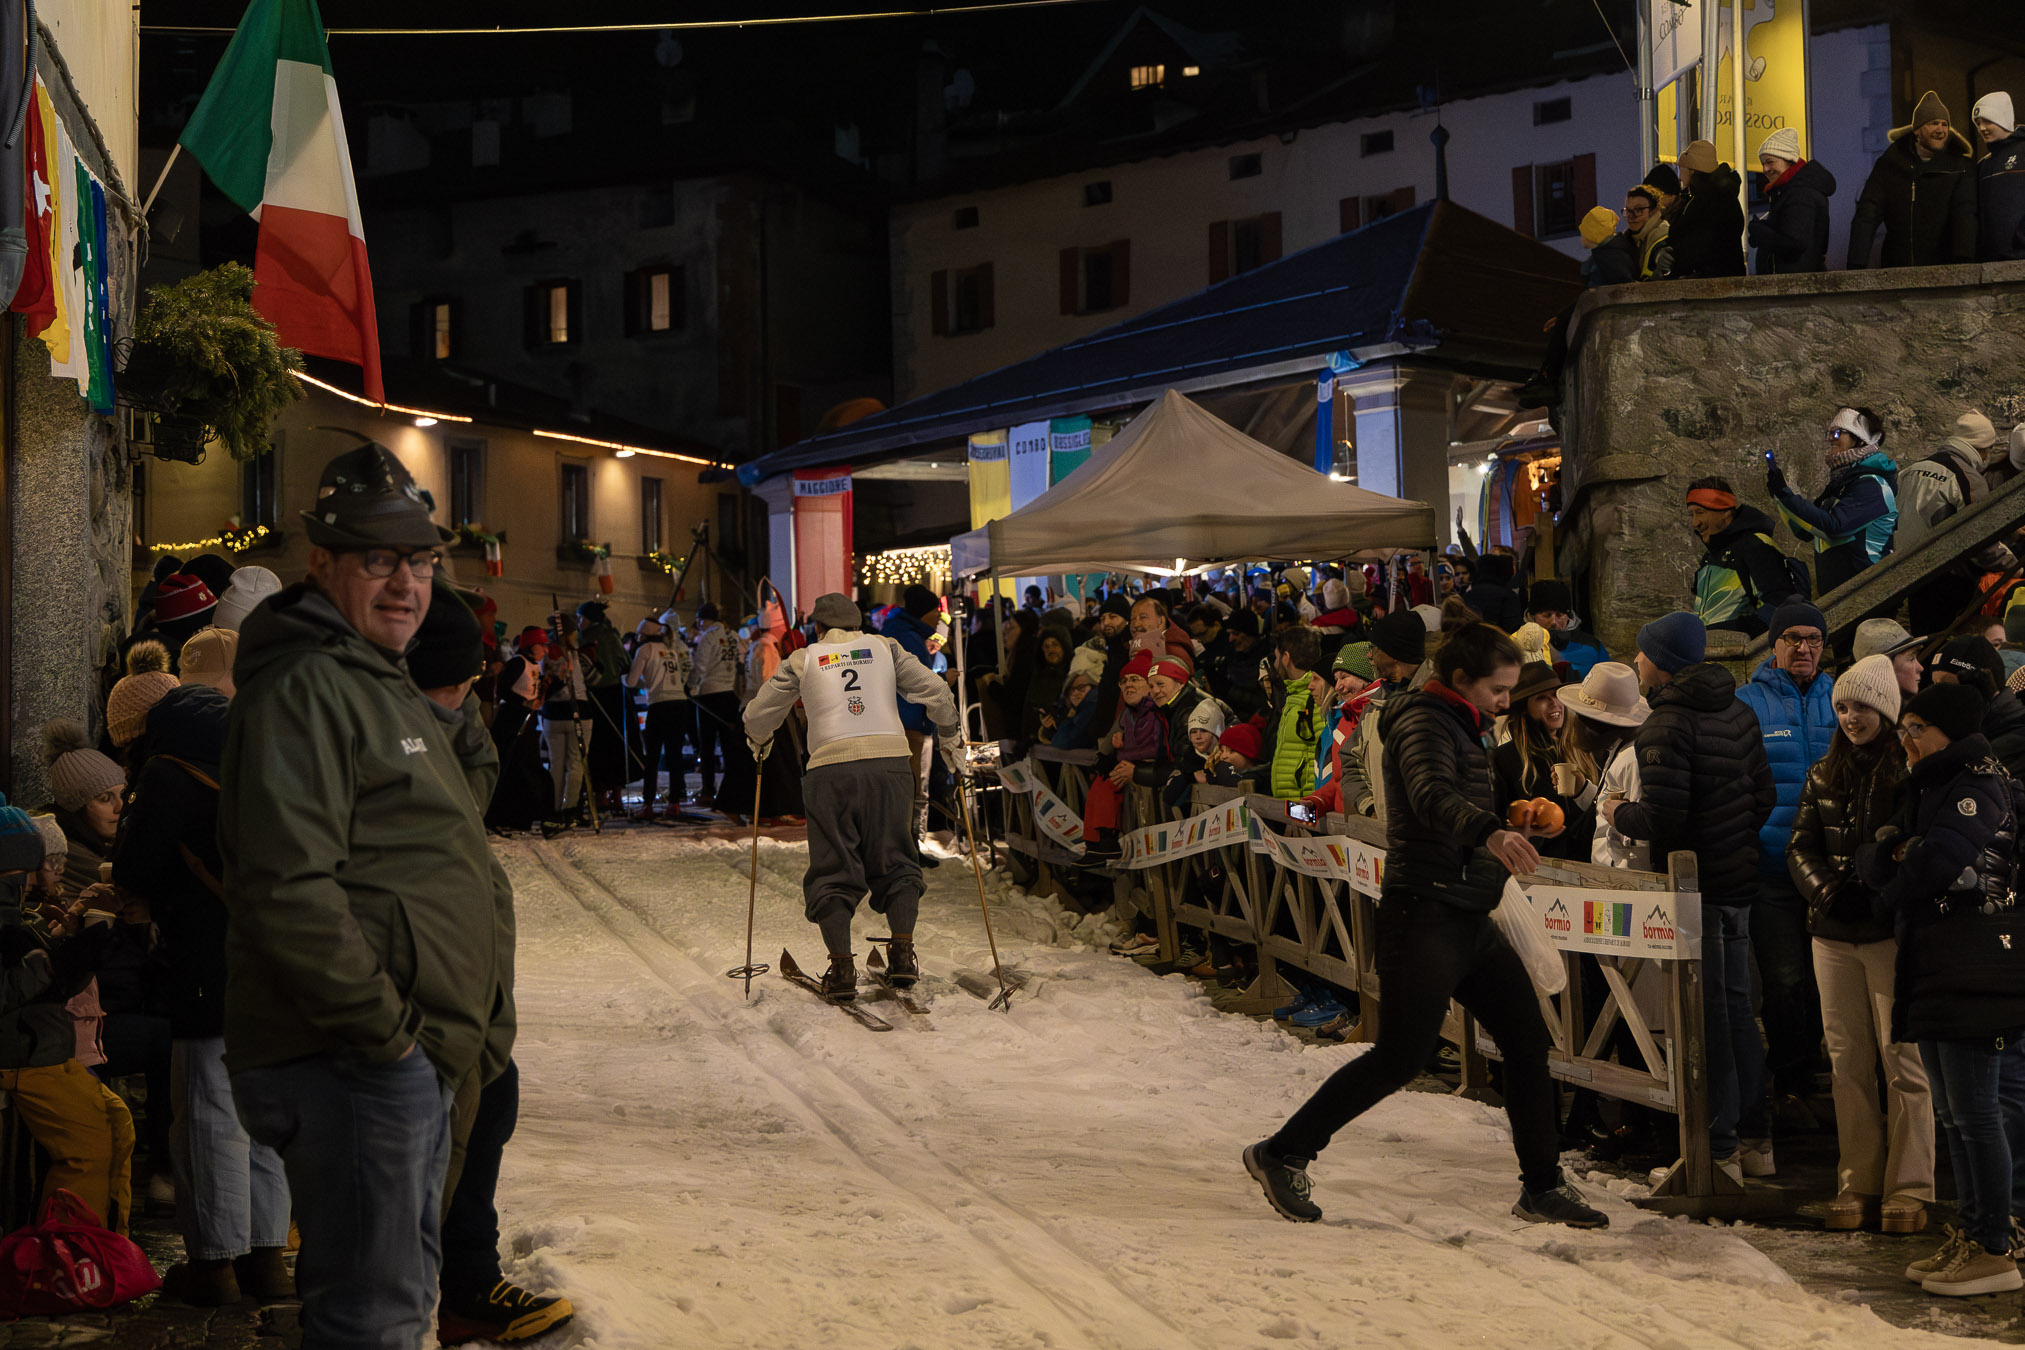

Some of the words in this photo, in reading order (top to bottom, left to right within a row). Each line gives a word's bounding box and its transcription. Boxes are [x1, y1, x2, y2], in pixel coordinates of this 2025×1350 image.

[1015, 437, 1046, 455] COMBO
[841, 668, 861, 693] 2
[1544, 913, 1571, 932] bormio
[1642, 921, 1675, 940] bormio
